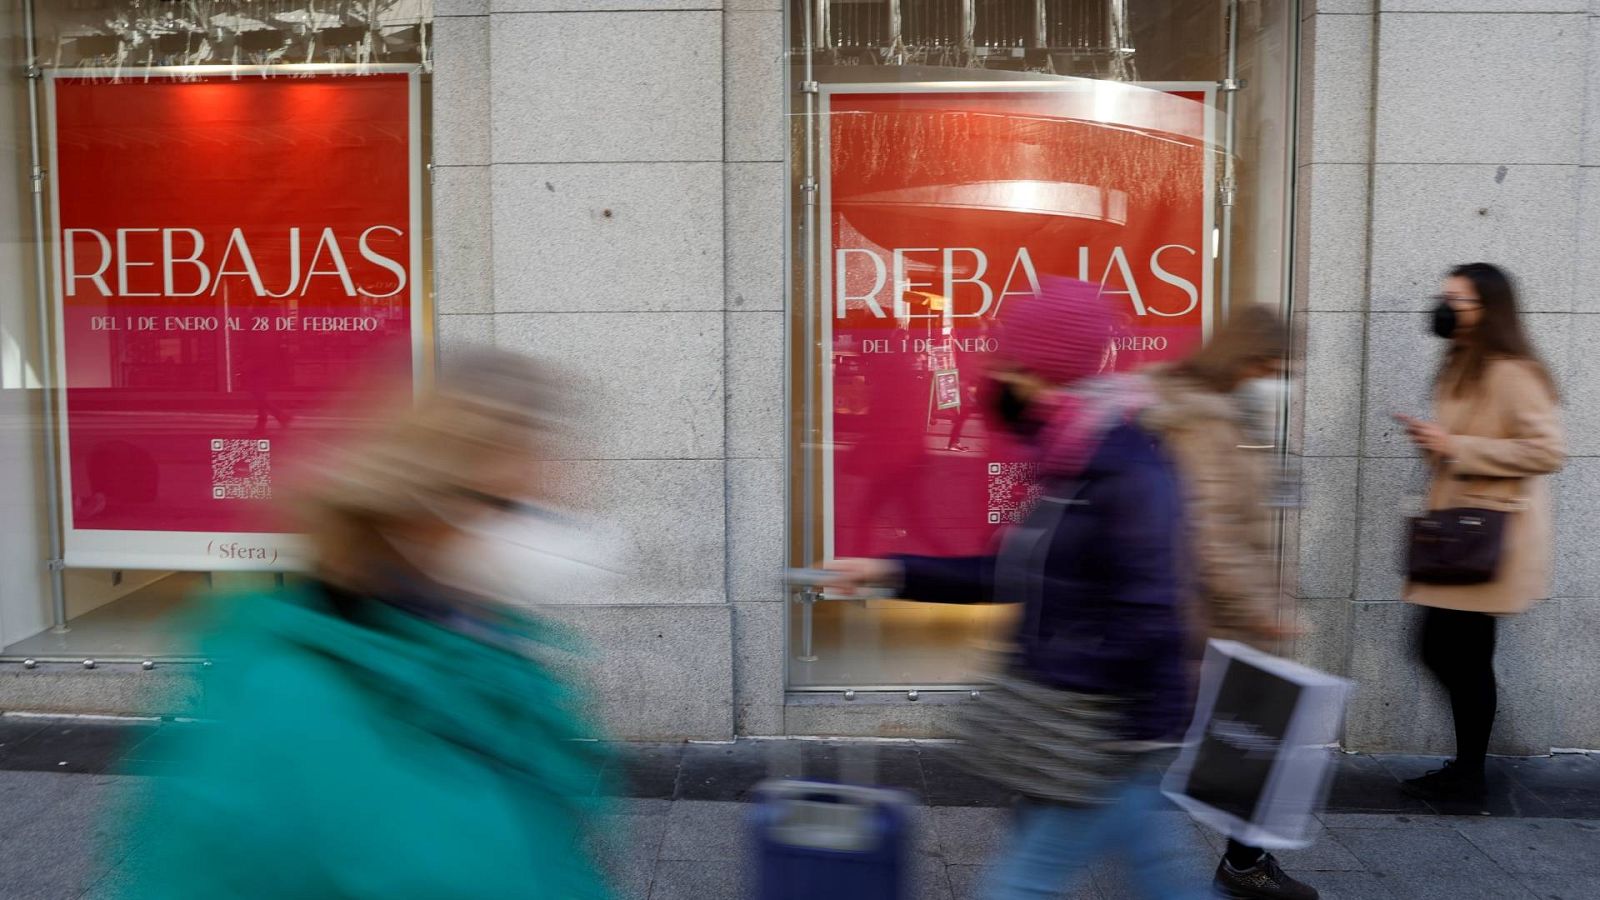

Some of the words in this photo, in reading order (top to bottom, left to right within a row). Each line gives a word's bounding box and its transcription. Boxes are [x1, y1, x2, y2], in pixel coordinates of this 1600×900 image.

[63, 225, 408, 299] REBAJAS
[91, 315, 121, 331] DEL
[138, 316, 159, 332] DE
[164, 316, 218, 332] ENERO
[224, 316, 246, 332] AL
[251, 316, 270, 332] 28
[275, 316, 298, 332] DE
[303, 316, 378, 332] FEBRERO
[862, 338, 894, 354] DEL
[913, 337, 935, 353] DE
[943, 337, 1000, 353] ENERO
[1111, 335, 1168, 351] BRERO
